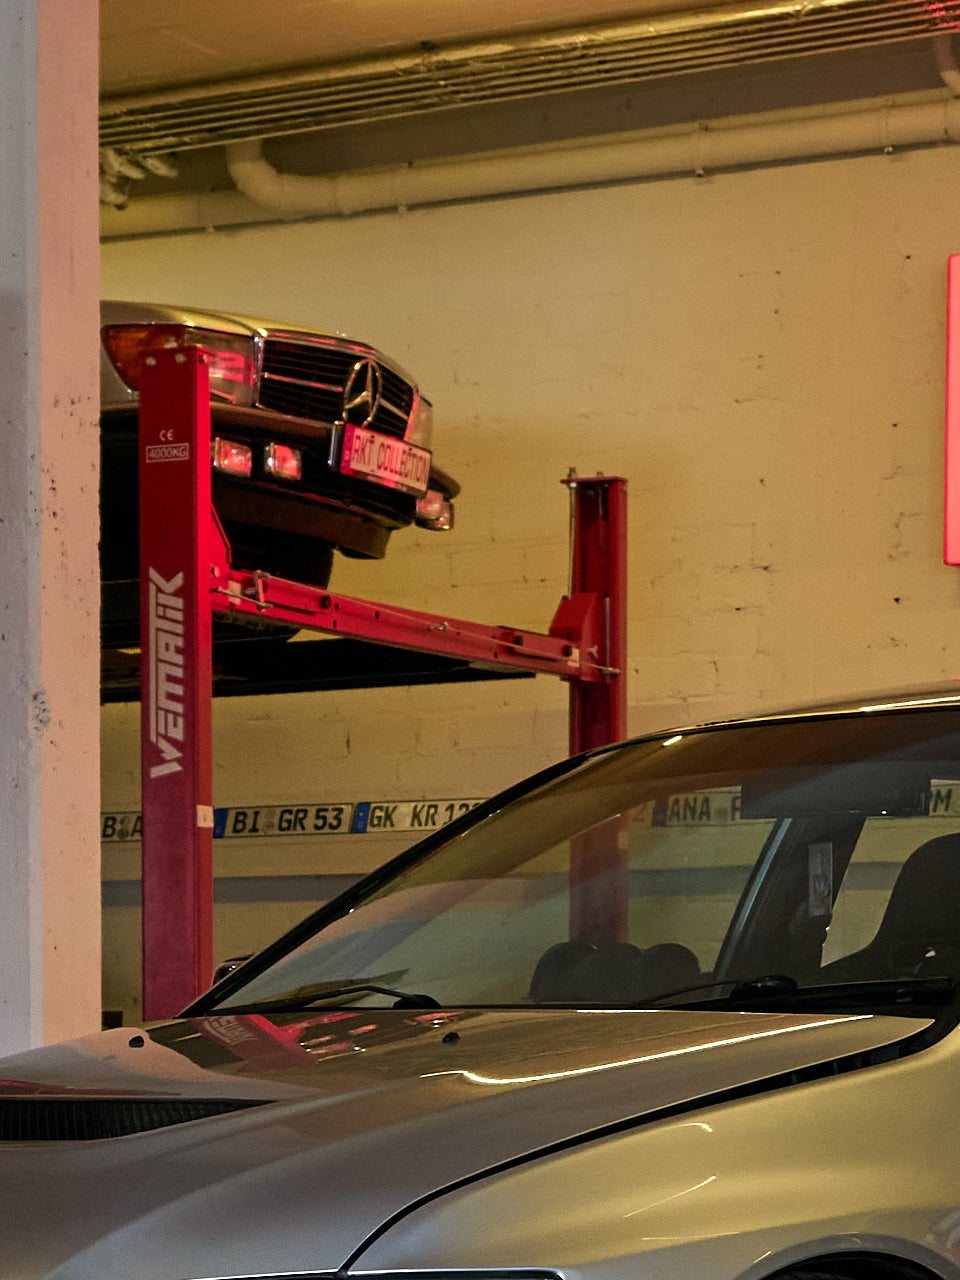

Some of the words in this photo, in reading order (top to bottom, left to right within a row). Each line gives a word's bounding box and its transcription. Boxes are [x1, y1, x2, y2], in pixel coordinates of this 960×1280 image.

[149, 446, 186, 458] 4000KG
[232, 810, 260, 834] BI
[278, 809, 309, 831] GR
[313, 807, 344, 831] 53
[369, 805, 398, 828] GK
[410, 804, 439, 827] KR
[669, 796, 712, 821] ANA
